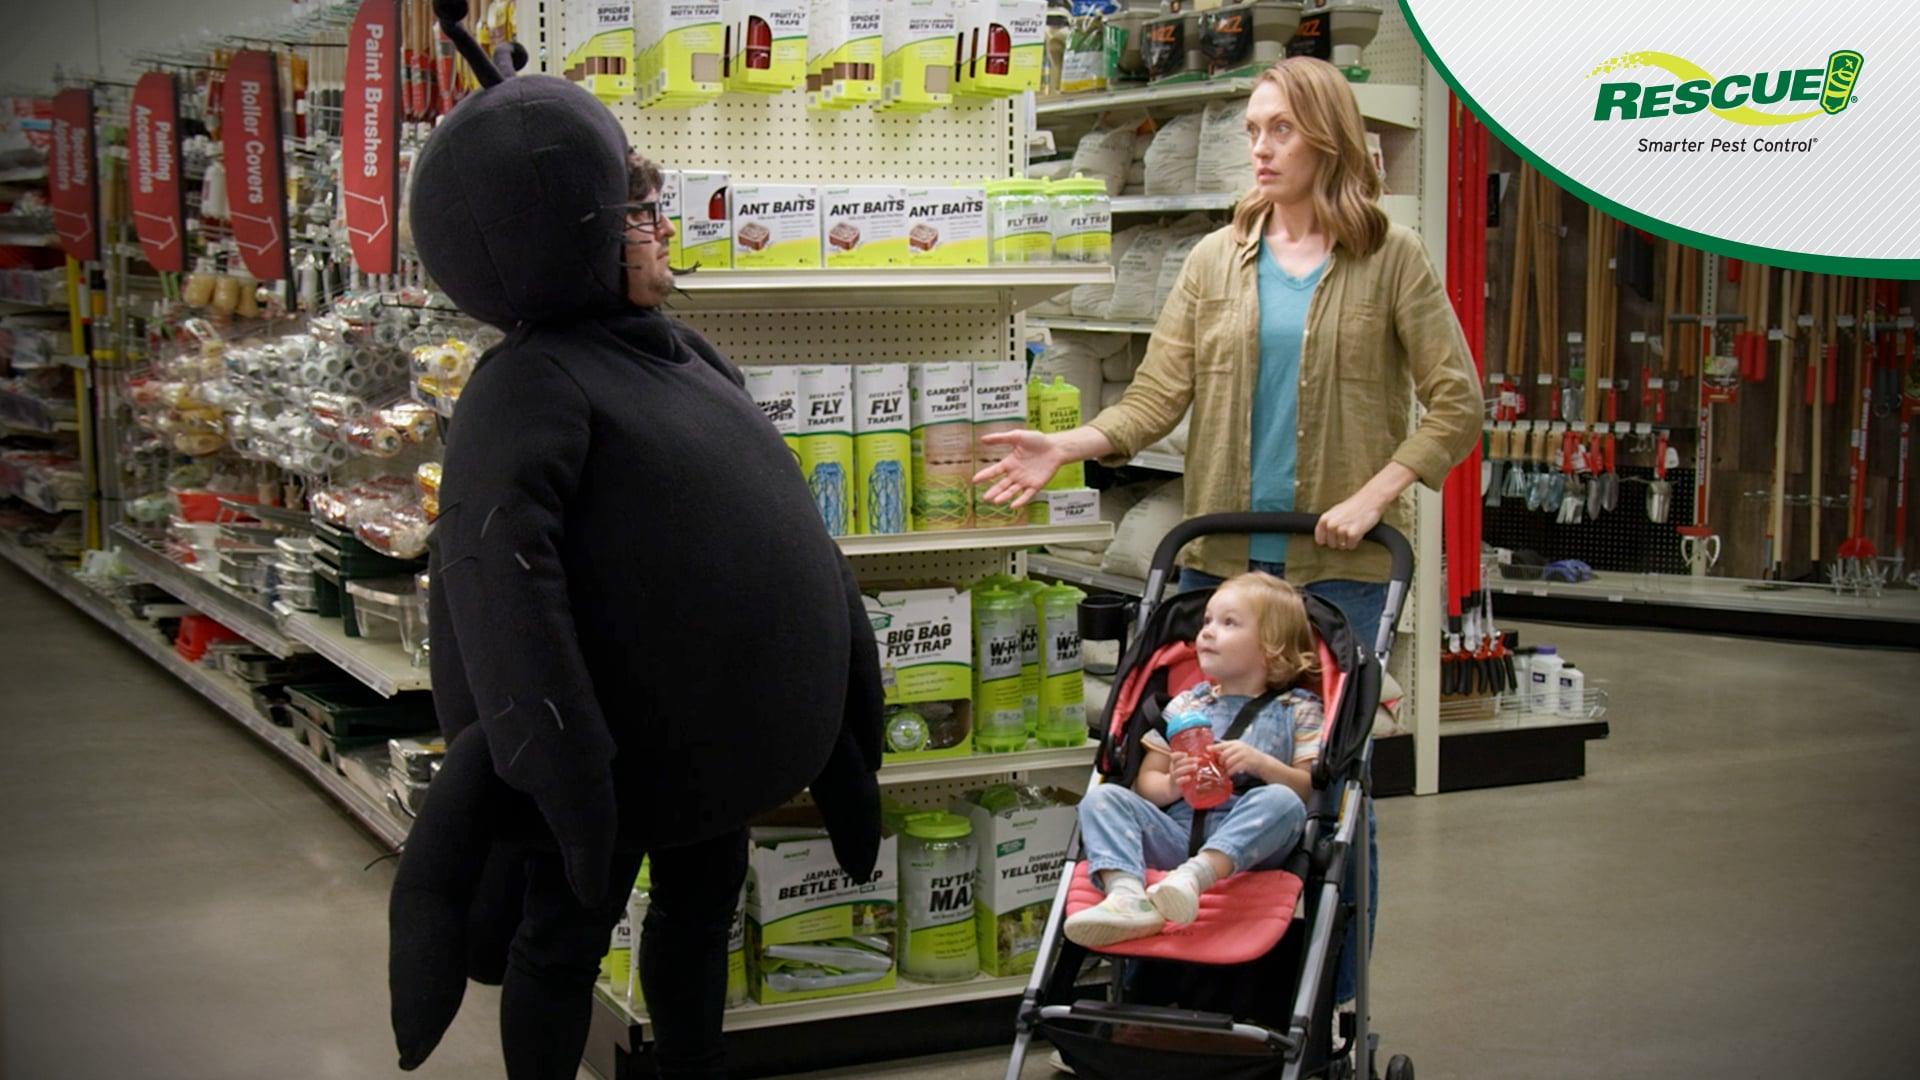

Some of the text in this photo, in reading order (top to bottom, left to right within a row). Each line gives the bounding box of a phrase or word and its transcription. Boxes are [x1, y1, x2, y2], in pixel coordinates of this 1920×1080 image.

[364, 24, 383, 177] Paint Brushes
[155, 121, 173, 181] Painting
[241, 81, 264, 204] Roller Covers
[738, 198, 815, 216] ANT BAITS
[830, 199, 905, 216] ANT BAITS
[909, 200, 984, 218] ANT BAITS
[1007, 219, 1024, 228] FLY
[1071, 218, 1088, 227] FLY
[811, 399, 842, 417] FLY
[871, 398, 901, 416] FLY
[1065, 508, 1085, 517] TRAP
[887, 623, 952, 645] BIG BAG
[886, 643, 911, 659] FLY
[914, 638, 952, 655] TRAP
[1057, 650, 1078, 661] TRAP
[991, 656, 1012, 667] TRAP
[1001, 858, 1067, 879] YELLOWJA
[778, 879, 837, 900] BEETLE
